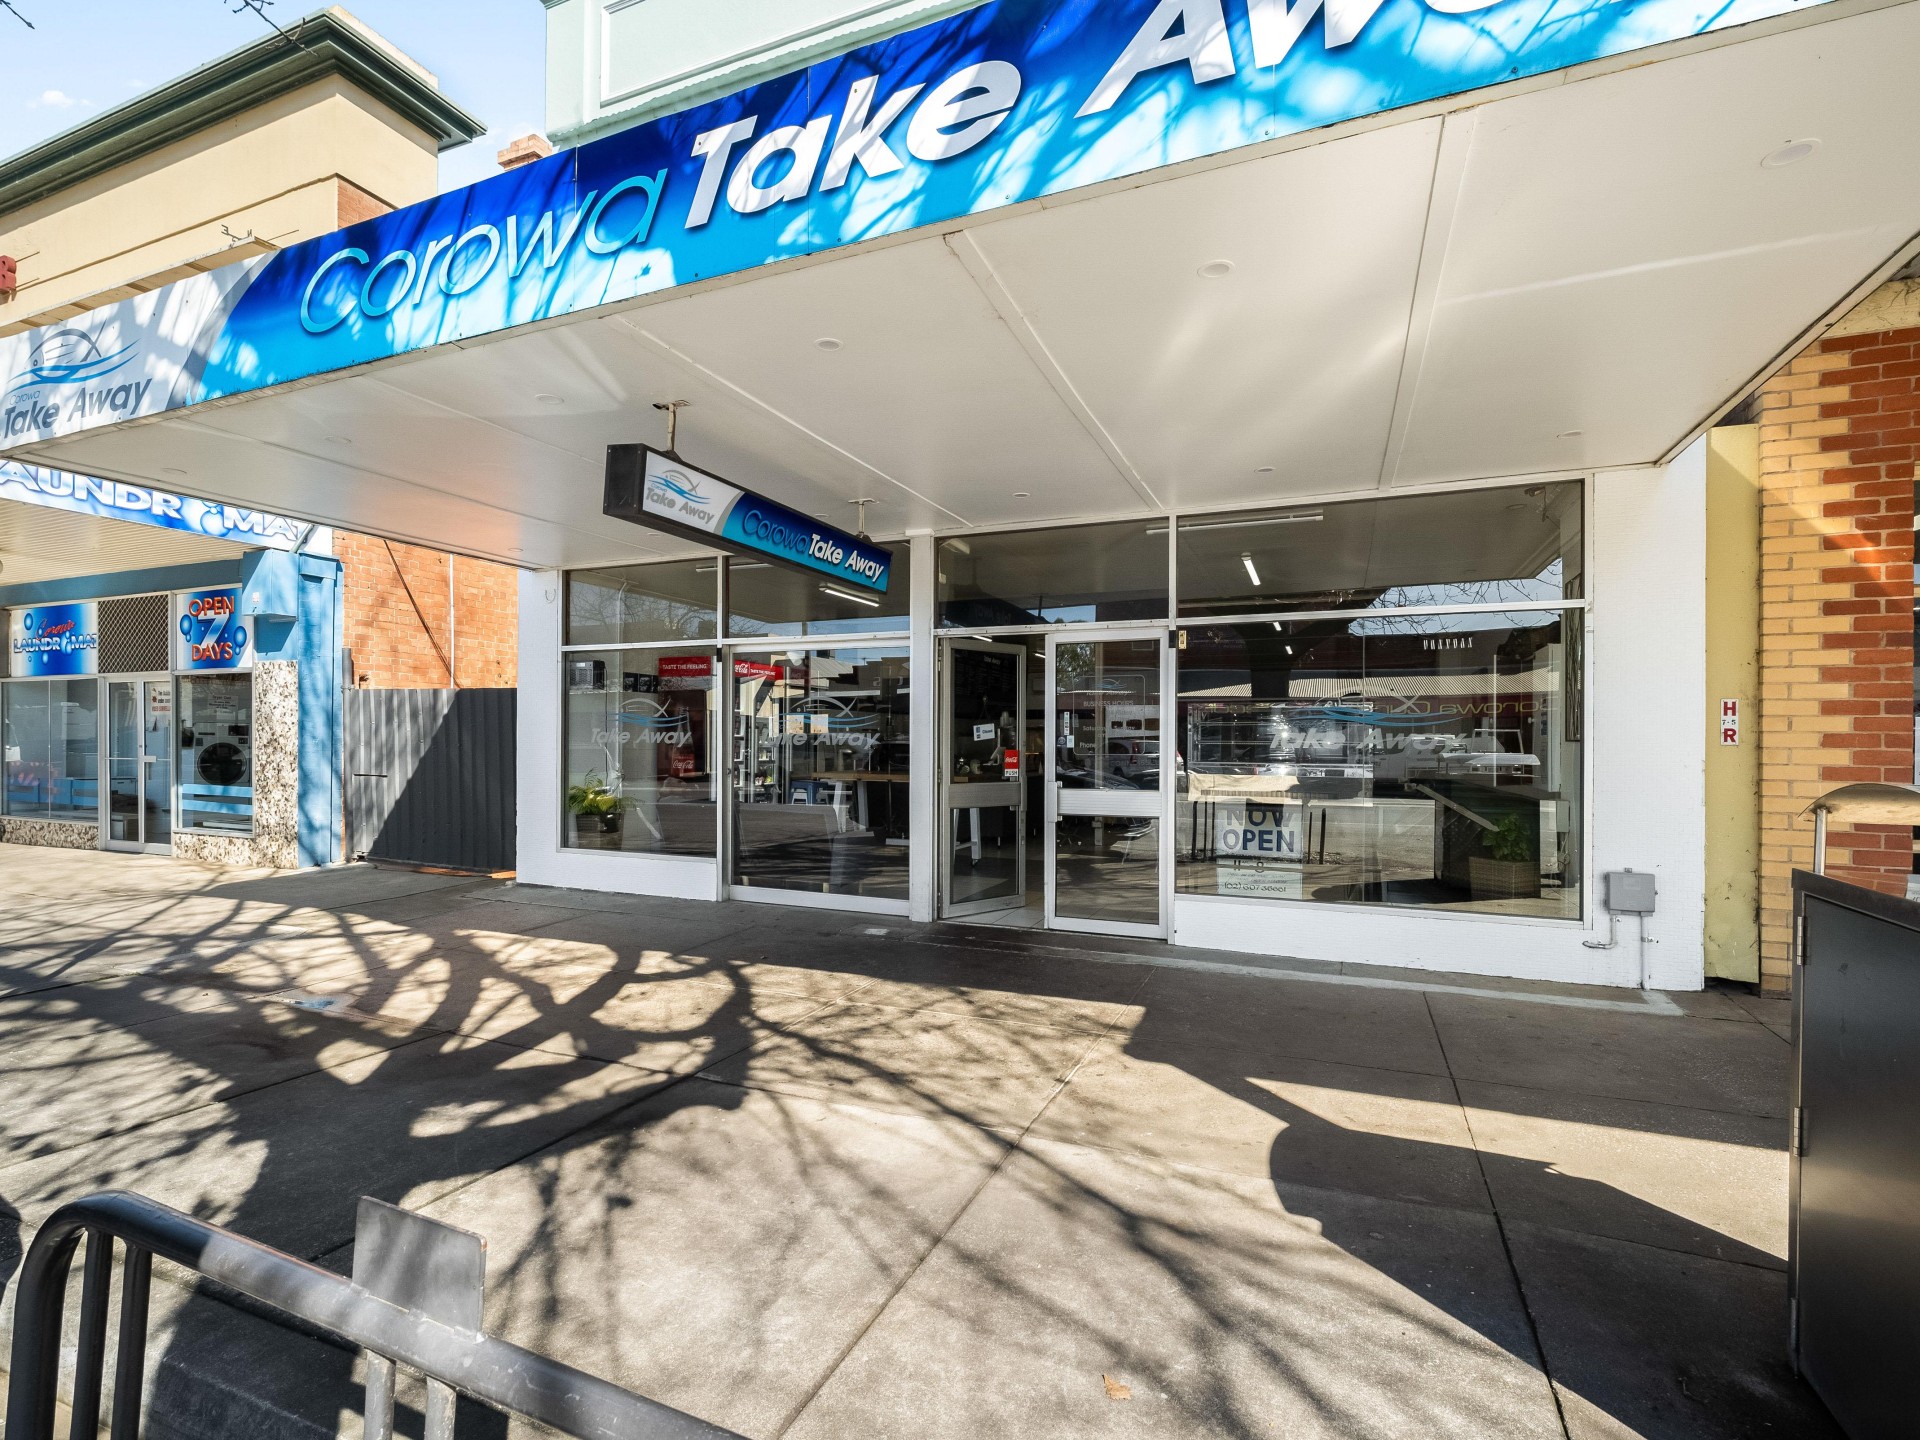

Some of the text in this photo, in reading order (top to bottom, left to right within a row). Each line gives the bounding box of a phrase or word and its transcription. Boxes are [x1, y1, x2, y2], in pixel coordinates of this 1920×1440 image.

[300, 167, 669, 335] Corowa
[684, 60, 1022, 231] Take
[4, 378, 152, 439] Take Away
[10, 390, 40, 405] Corowa
[646, 487, 715, 524] Take Away
[743, 510, 884, 582] Corowa Take Away
[189, 596, 234, 617] OPEN
[197, 609, 230, 648] 7
[192, 642, 233, 661] DAYS
[1723, 701, 1736, 716] H
[590, 728, 692, 747] Take Away
[815, 732, 882, 750] Away
[1269, 728, 1468, 753] Take Away
[1723, 728, 1737, 742] R
[1226, 806, 1295, 828] NOW
[1223, 829, 1295, 852] OPEN
